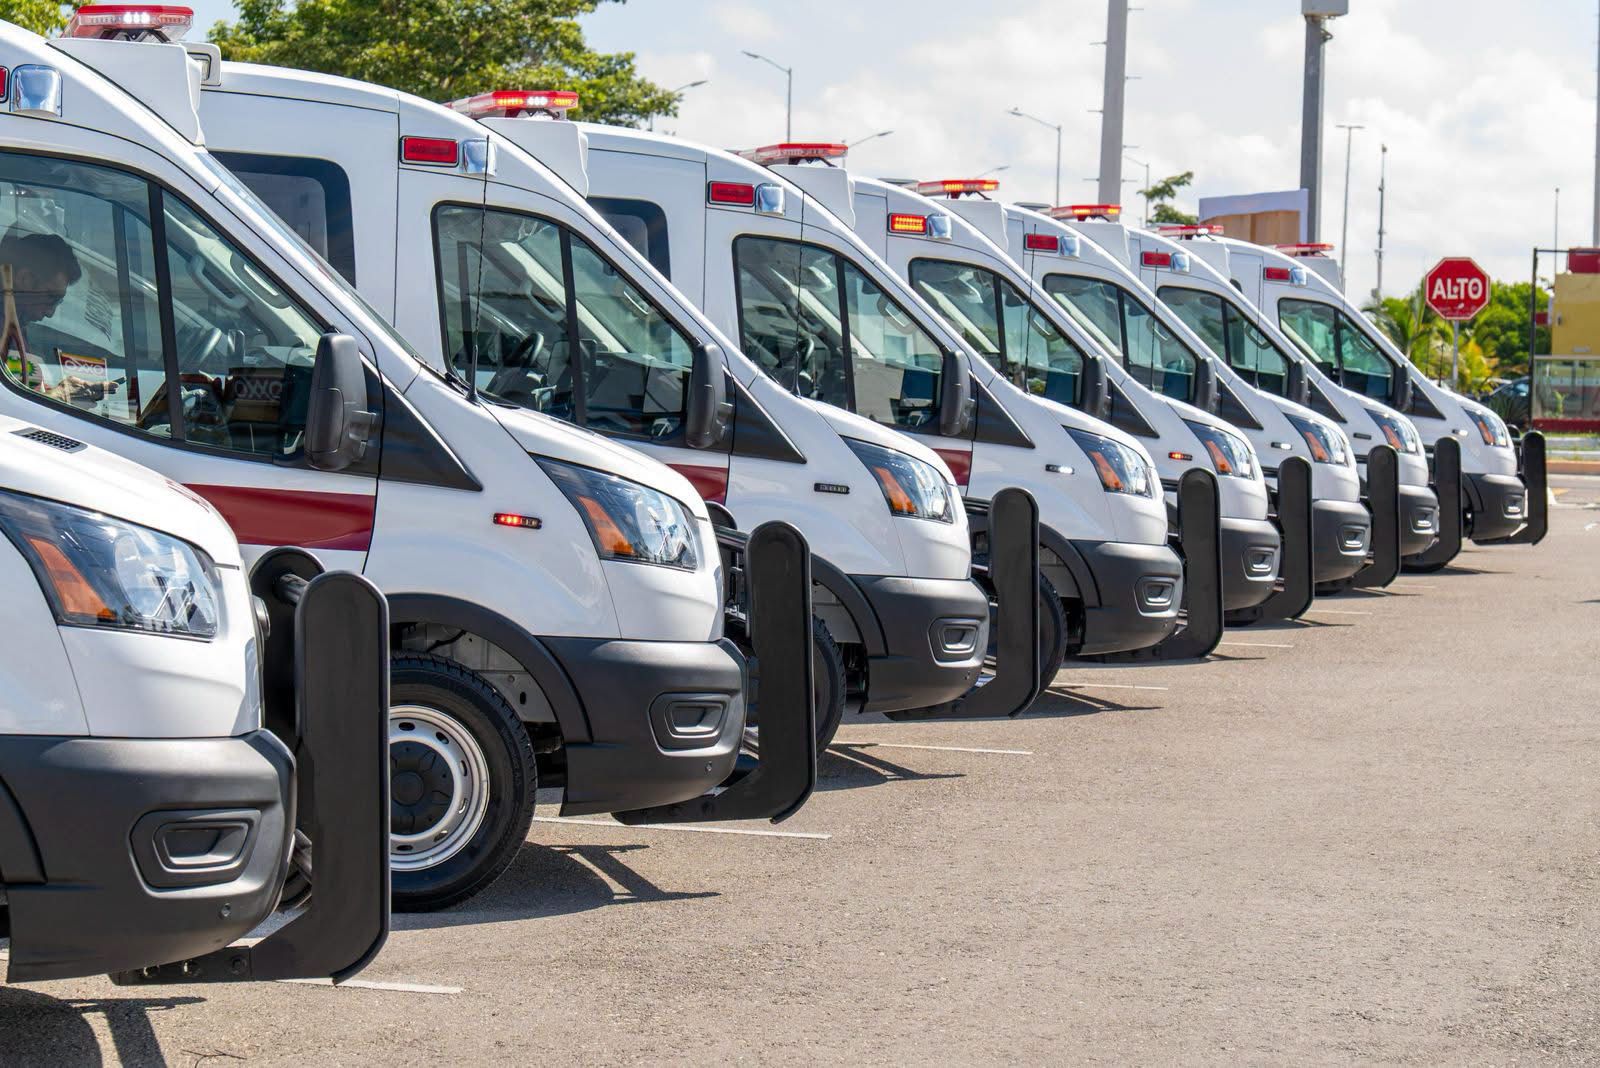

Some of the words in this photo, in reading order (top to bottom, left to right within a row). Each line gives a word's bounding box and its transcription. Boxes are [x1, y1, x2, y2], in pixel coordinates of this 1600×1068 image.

[1432, 278, 1483, 300] ALTO
[64, 359, 105, 376] OXXO
[235, 377, 283, 400] OXXO
